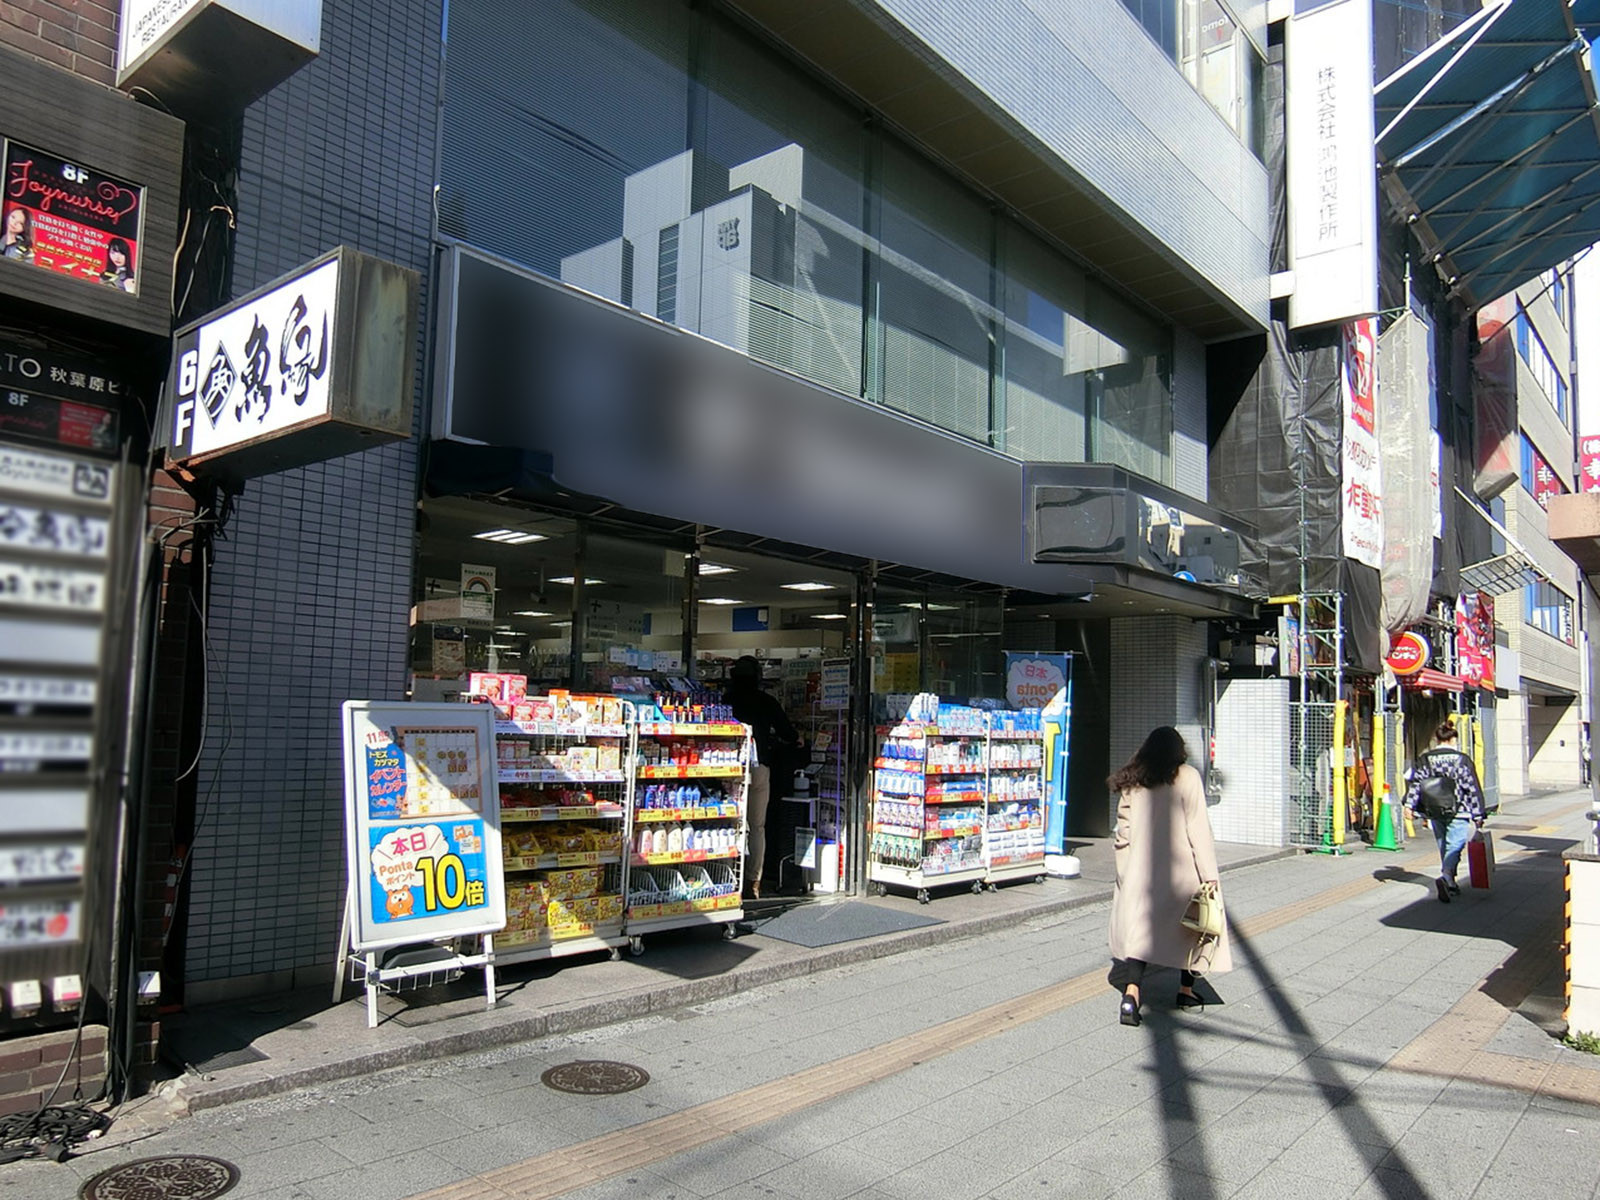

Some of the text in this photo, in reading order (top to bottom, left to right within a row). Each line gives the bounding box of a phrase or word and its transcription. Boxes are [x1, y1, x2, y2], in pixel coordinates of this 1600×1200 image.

[61, 163, 90, 184] 8F
[0, 353, 42, 378] TO
[8, 392, 29, 407] 8F
[390, 832, 427, 856] 本日
[379, 861, 414, 877] Ponta
[386, 872, 415, 886] ポイント
